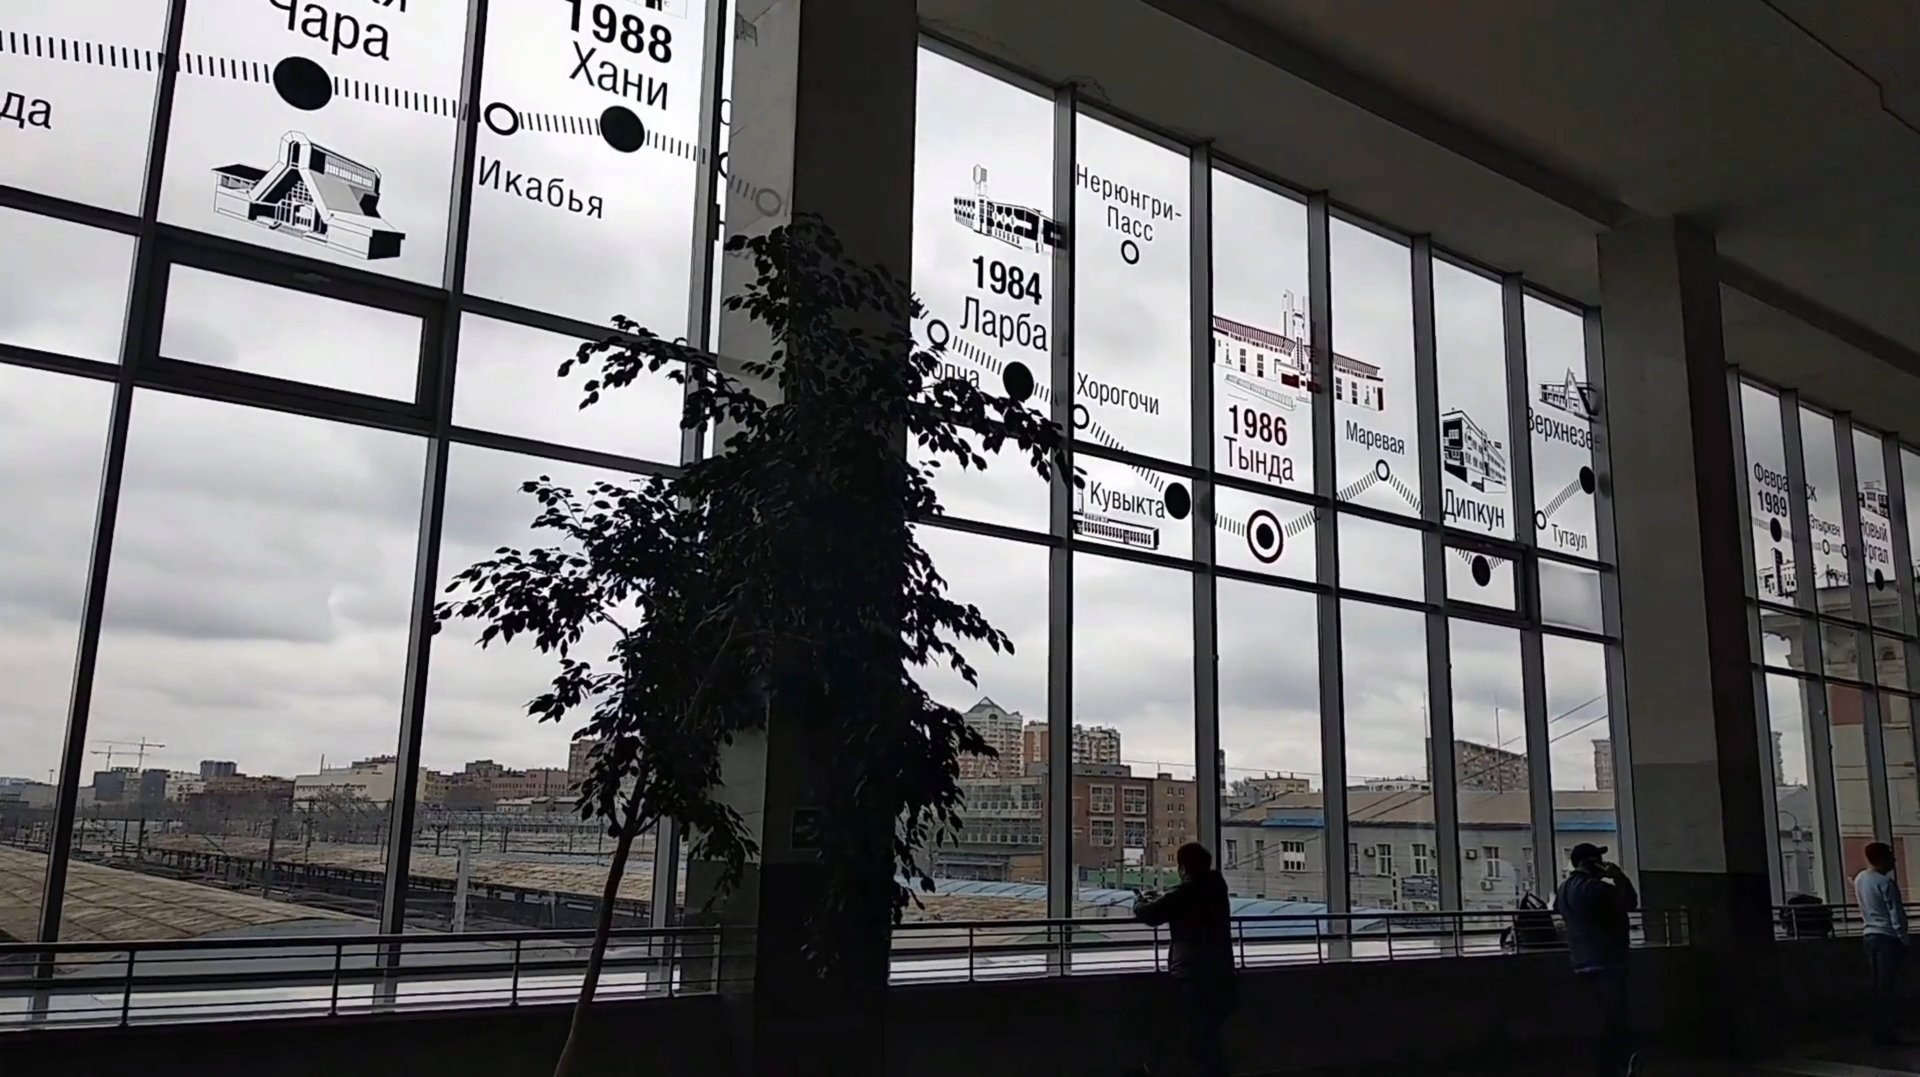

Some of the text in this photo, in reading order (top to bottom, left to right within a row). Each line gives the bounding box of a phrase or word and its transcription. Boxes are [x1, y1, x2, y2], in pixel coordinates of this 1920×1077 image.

[565, 0, 673, 64] 1988
[569, 40, 669, 111] Хани
[478, 155, 604, 220] Икабья
[1076, 163, 1182, 221] Нерюнгри-
[1107, 204, 1154, 242] Пасс
[972, 255, 1043, 305] 1984
[960, 296, 1049, 352] Ларба
[1076, 371, 1160, 416] Хорогочи
[1228, 404, 1289, 447] 1986
[1345, 419, 1406, 456] Маревая
[1223, 436, 1295, 485] Тында
[1090, 480, 1166, 521] Кувыкта
[1443, 487, 1505, 532] Дипкун
[1757, 489, 1788, 518] 1989
[1551, 523, 1588, 551] Тутаул
